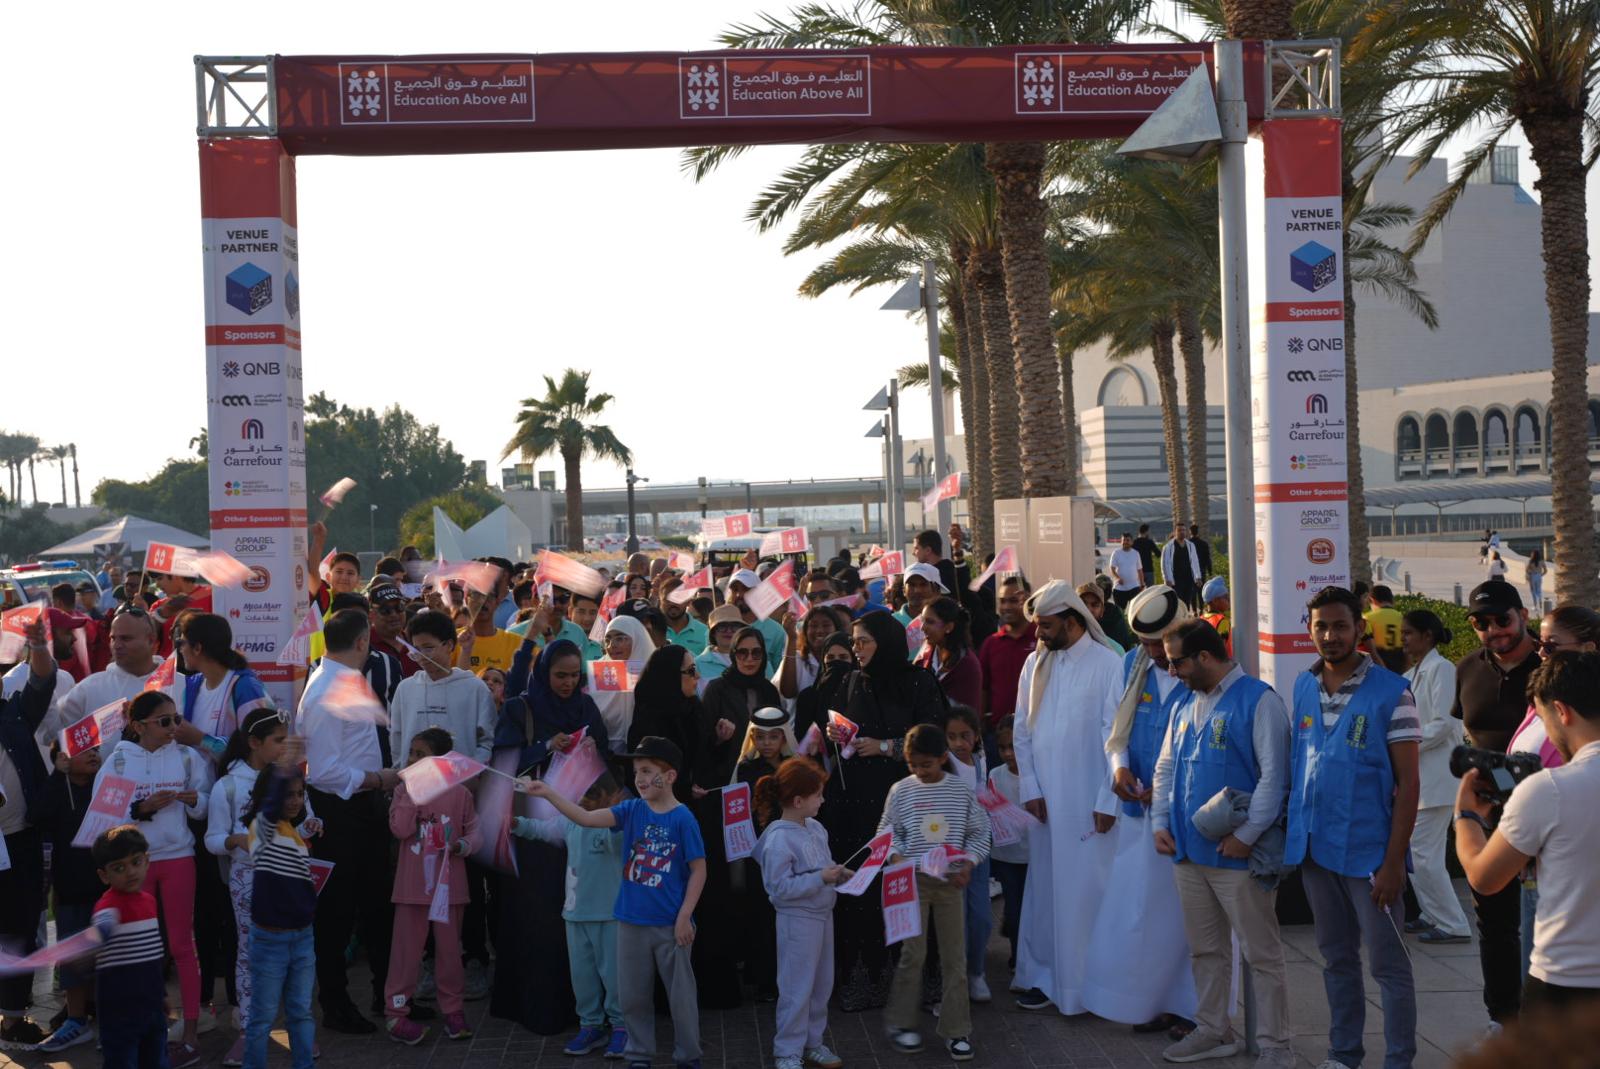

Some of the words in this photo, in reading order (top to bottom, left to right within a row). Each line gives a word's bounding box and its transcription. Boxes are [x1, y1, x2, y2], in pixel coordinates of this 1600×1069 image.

[733, 71, 779, 87] الجميع
[782, 72, 815, 85] فوق
[1068, 67, 1114, 83] الجميع
[1116, 68, 1149, 81] فوق
[394, 76, 441, 93] الجميع
[444, 77, 478, 91] فوق
[1067, 83, 1131, 96] Education
[1134, 84, 1176, 96] Above
[394, 94, 460, 106] Education
[463, 93, 507, 105] Above
[510, 92, 527, 104] All
[733, 88, 797, 101] Education
[800, 87, 843, 99] Above
[846, 87, 863, 99] All
[1291, 208, 1334, 219] VENUE
[1286, 221, 1342, 232] PARTNER
[226, 229, 269, 240] VENUE
[221, 243, 279, 253] PARTNER
[1289, 307, 1340, 318] Sponsors
[224, 330, 276, 341] Sponsors
[1307, 337, 1344, 351] QNB
[243, 362, 281, 376] QNB
[223, 455, 282, 466] Carrefour
[1289, 488, 1312, 496] Other
[1301, 509, 1339, 518] APPAREL
[224, 515, 248, 523] Other
[249, 515, 285, 524] Sponsors
[1301, 517, 1332, 526] GROUP
[235, 536, 276, 545] APPAREL
[235, 544, 268, 553] GROUP
[1386, 624, 1397, 647] 5
[235, 641, 275, 653] KPMG
